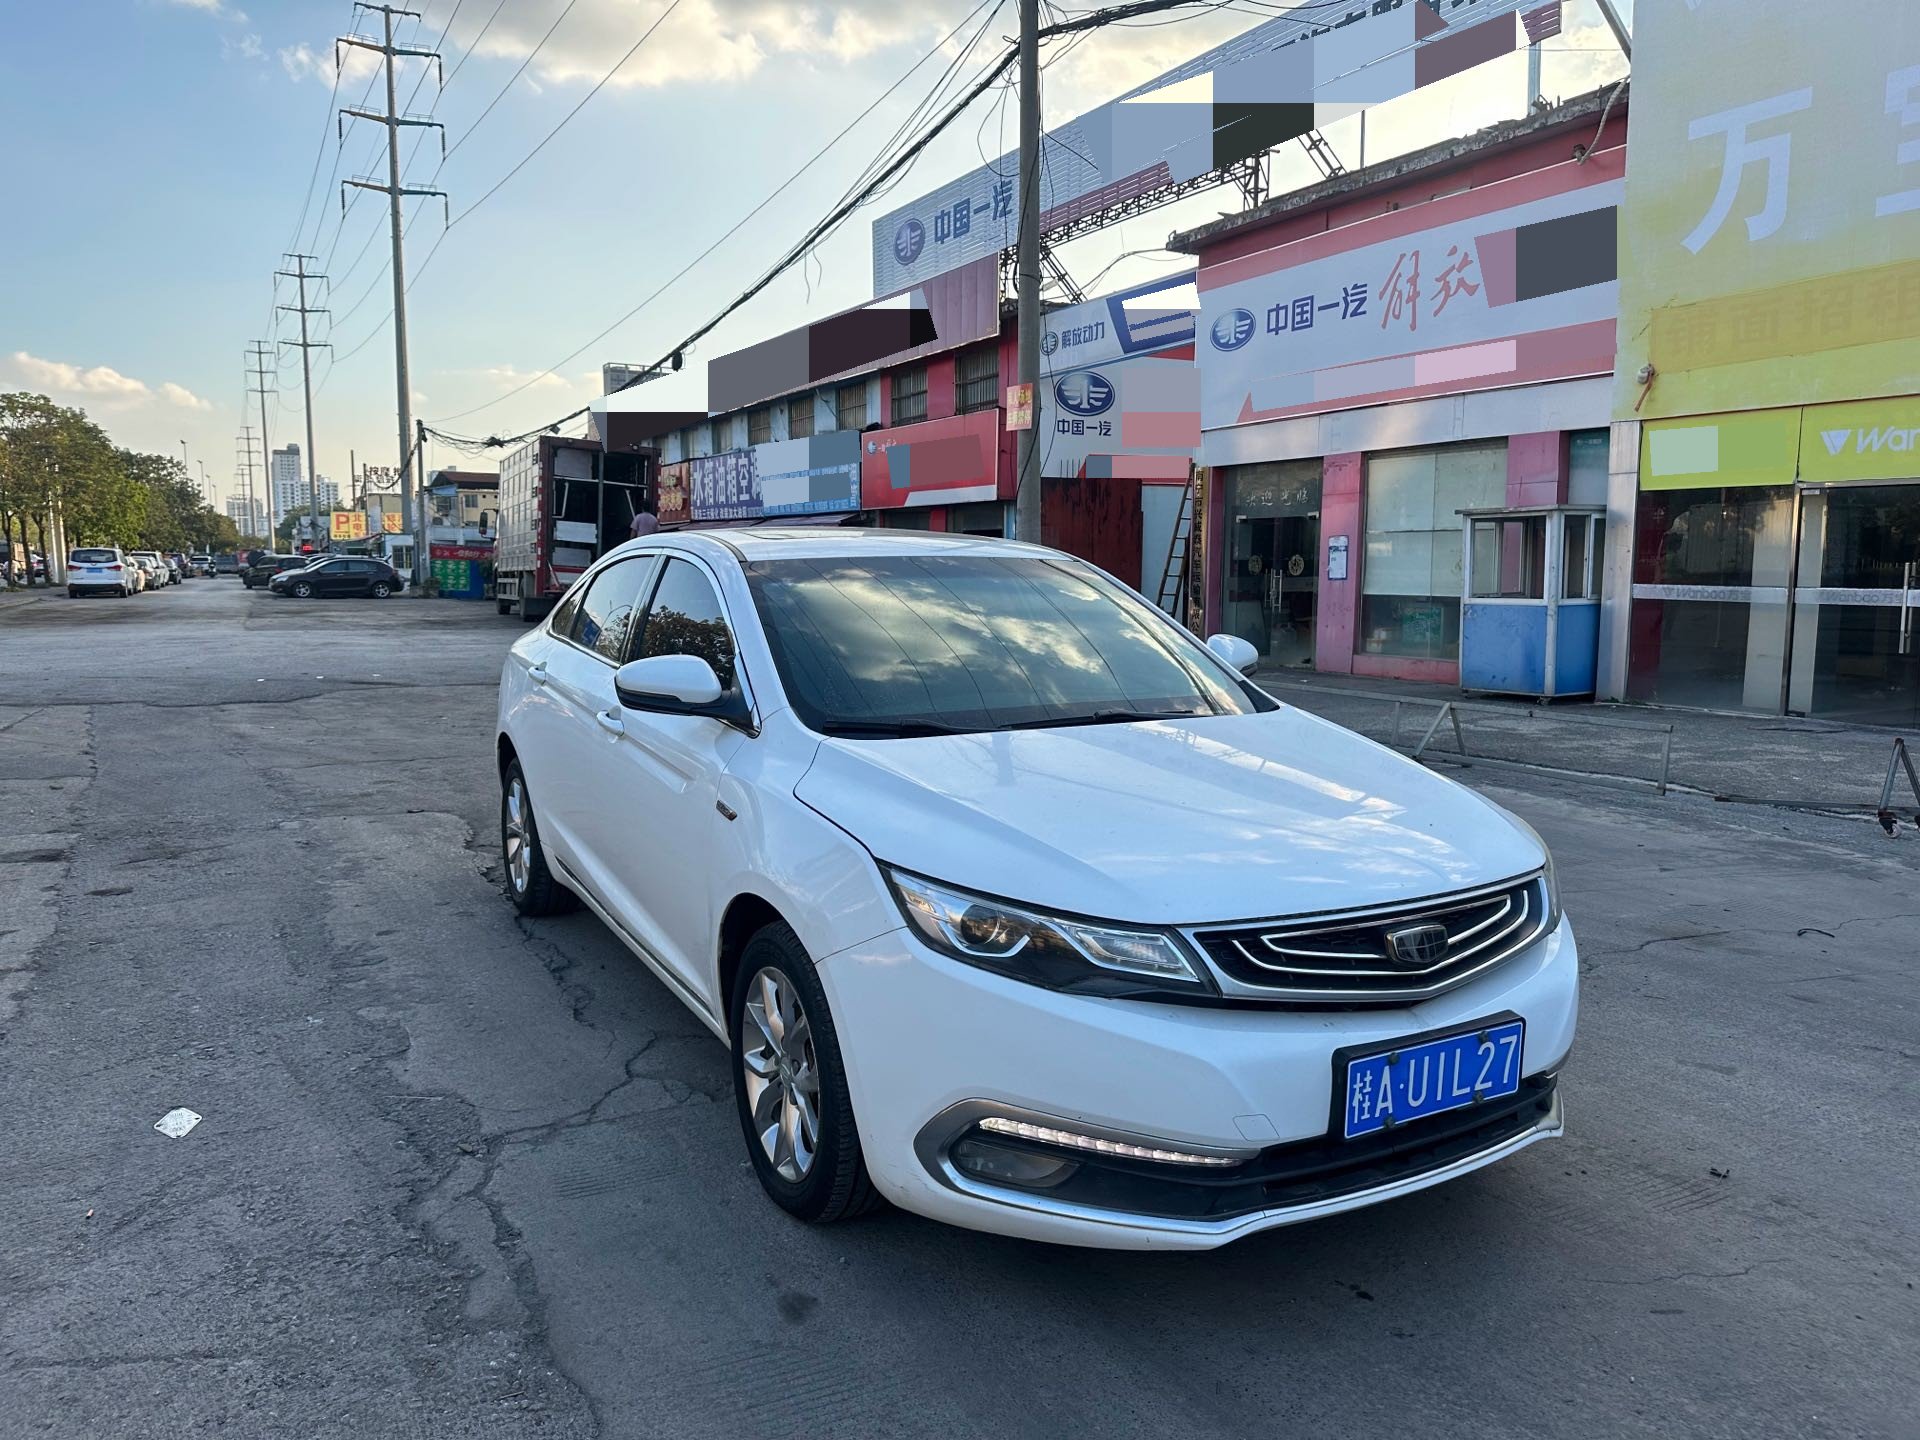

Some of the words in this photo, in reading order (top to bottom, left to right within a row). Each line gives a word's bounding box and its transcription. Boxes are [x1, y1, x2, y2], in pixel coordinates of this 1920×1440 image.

[934, 180, 1013, 244] 中国一汽
[1266, 283, 1368, 336] 中国一汽
[1061, 321, 1105, 350] 解放动力
[1057, 418, 1112, 437] 中国一汽
[335, 513, 350, 531] P
